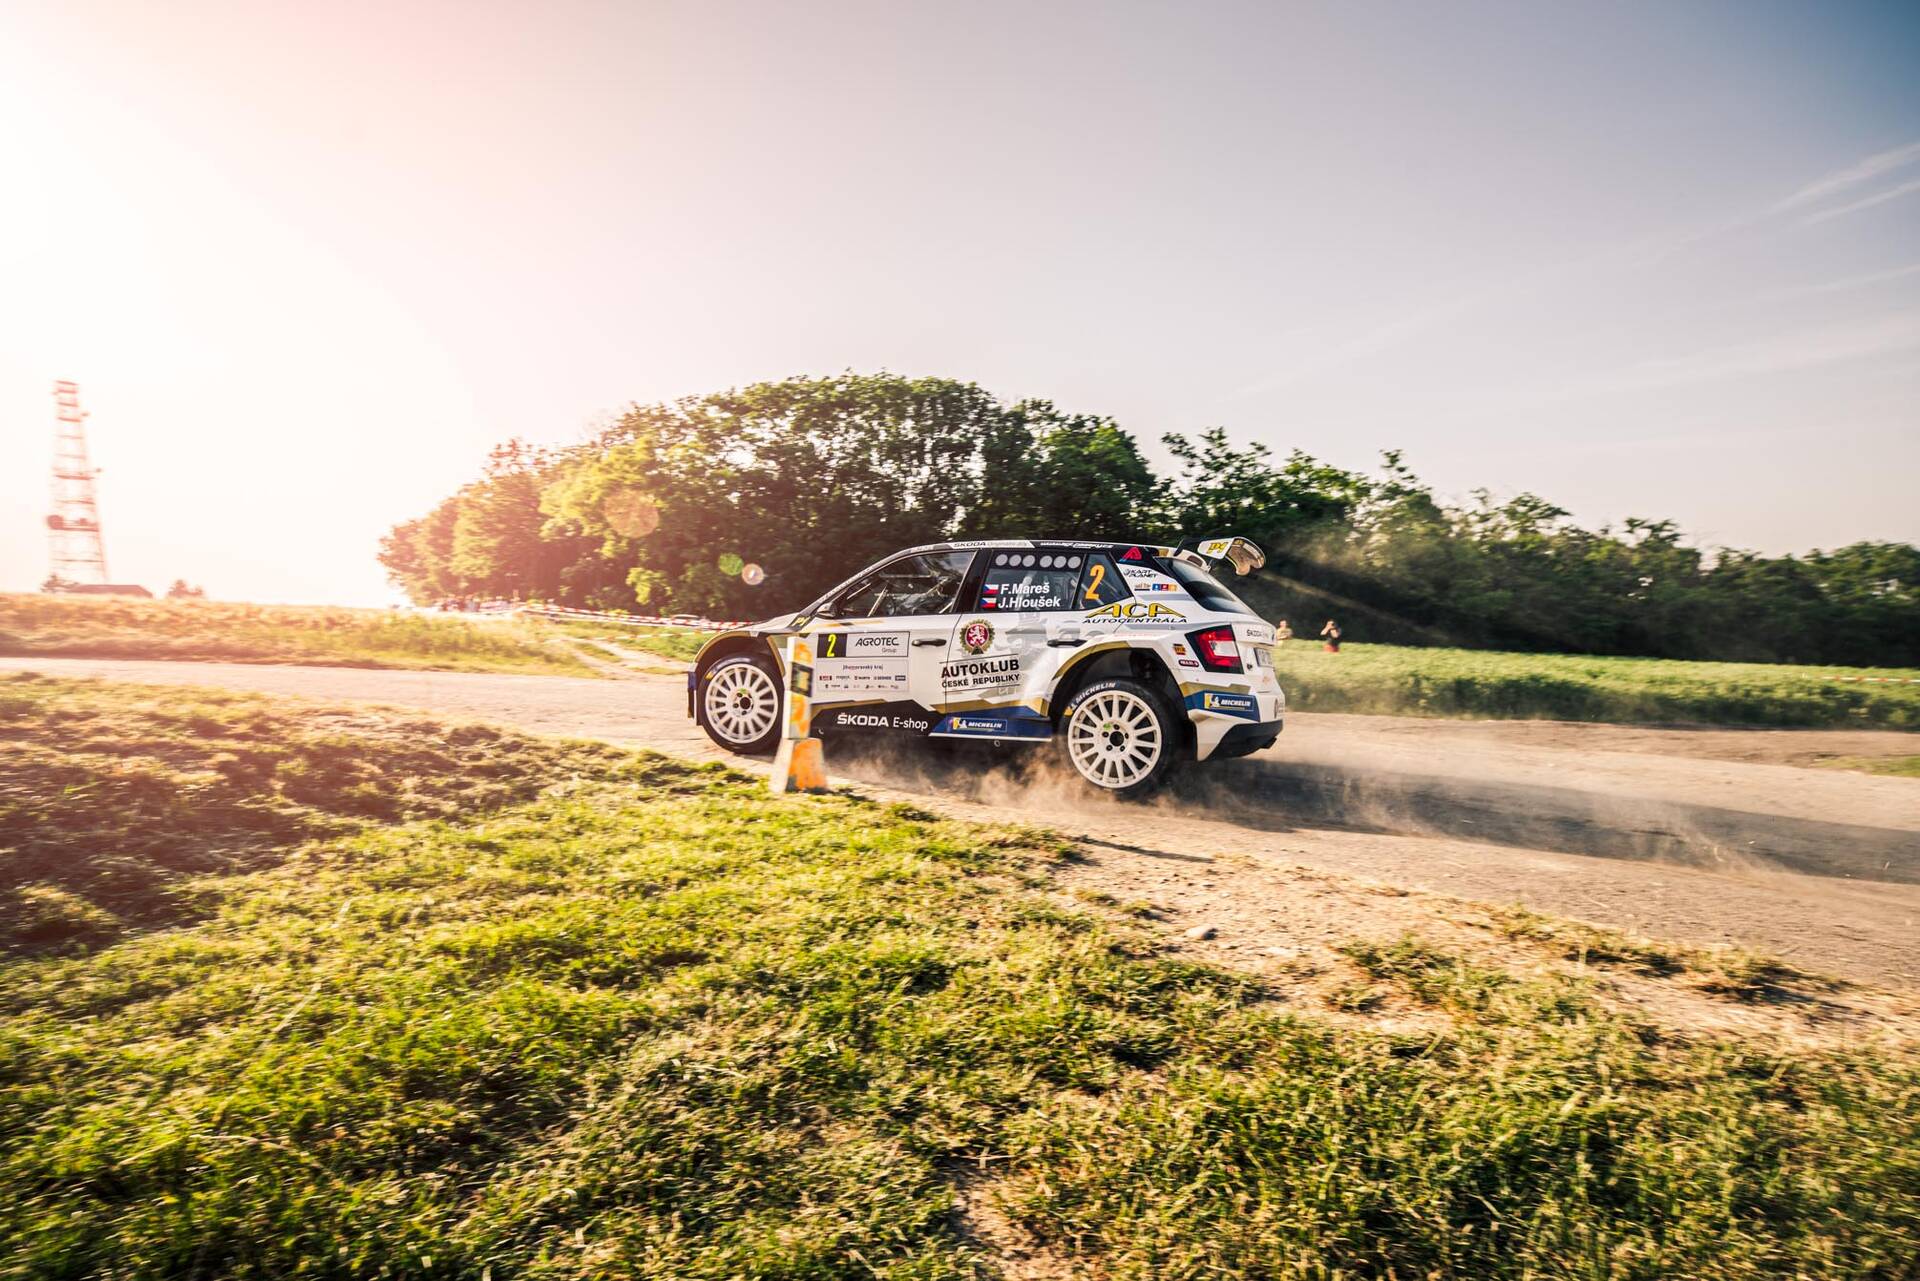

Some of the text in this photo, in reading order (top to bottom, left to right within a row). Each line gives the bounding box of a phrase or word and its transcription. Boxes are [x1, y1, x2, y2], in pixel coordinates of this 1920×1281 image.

[1000, 581, 1050, 595] F.Mareš
[1085, 564, 1105, 600] 2
[997, 596, 1061, 609] J.Hloušek
[1085, 602, 1187, 618] ACA
[826, 633, 837, 658] 2
[855, 637, 900, 647] AGROTEC
[941, 659, 1020, 678] AUTOKLUB
[972, 673, 1020, 685] REPUBLIKY
[1075, 682, 1116, 704] MICHELIN
[1220, 699, 1252, 707] MICHELIN
[837, 712, 929, 732] ŠKODA E-shop
